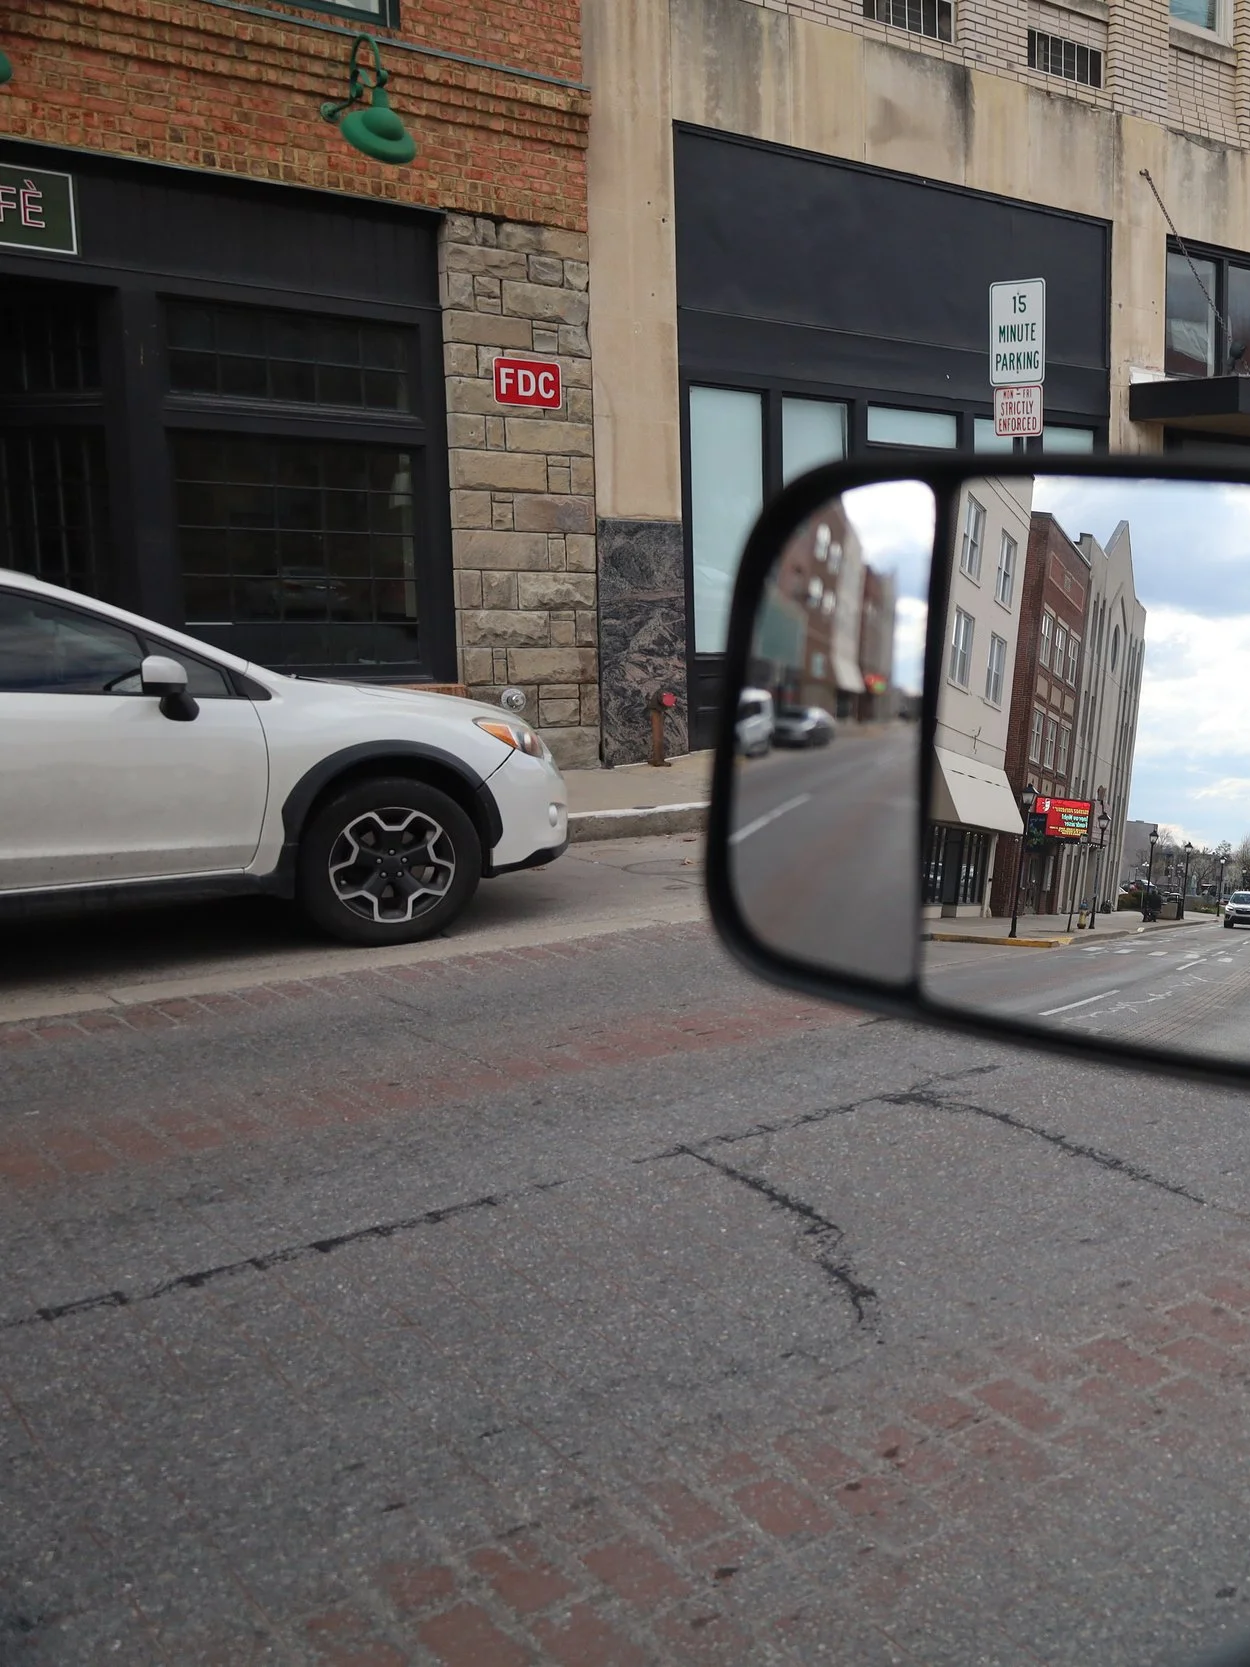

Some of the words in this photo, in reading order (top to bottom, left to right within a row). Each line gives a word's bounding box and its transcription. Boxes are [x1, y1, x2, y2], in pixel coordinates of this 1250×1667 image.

[1012, 295, 1027, 314] 15
[998, 323, 1037, 343] MINUTE
[995, 350, 1040, 372] PARKING
[499, 367, 556, 399] FDC
[1002, 388, 1014, 399] MON
[1022, 388, 1032, 398] FRI
[1000, 401, 1034, 416] STRICTLY
[998, 417, 1037, 433] ENFORCED
